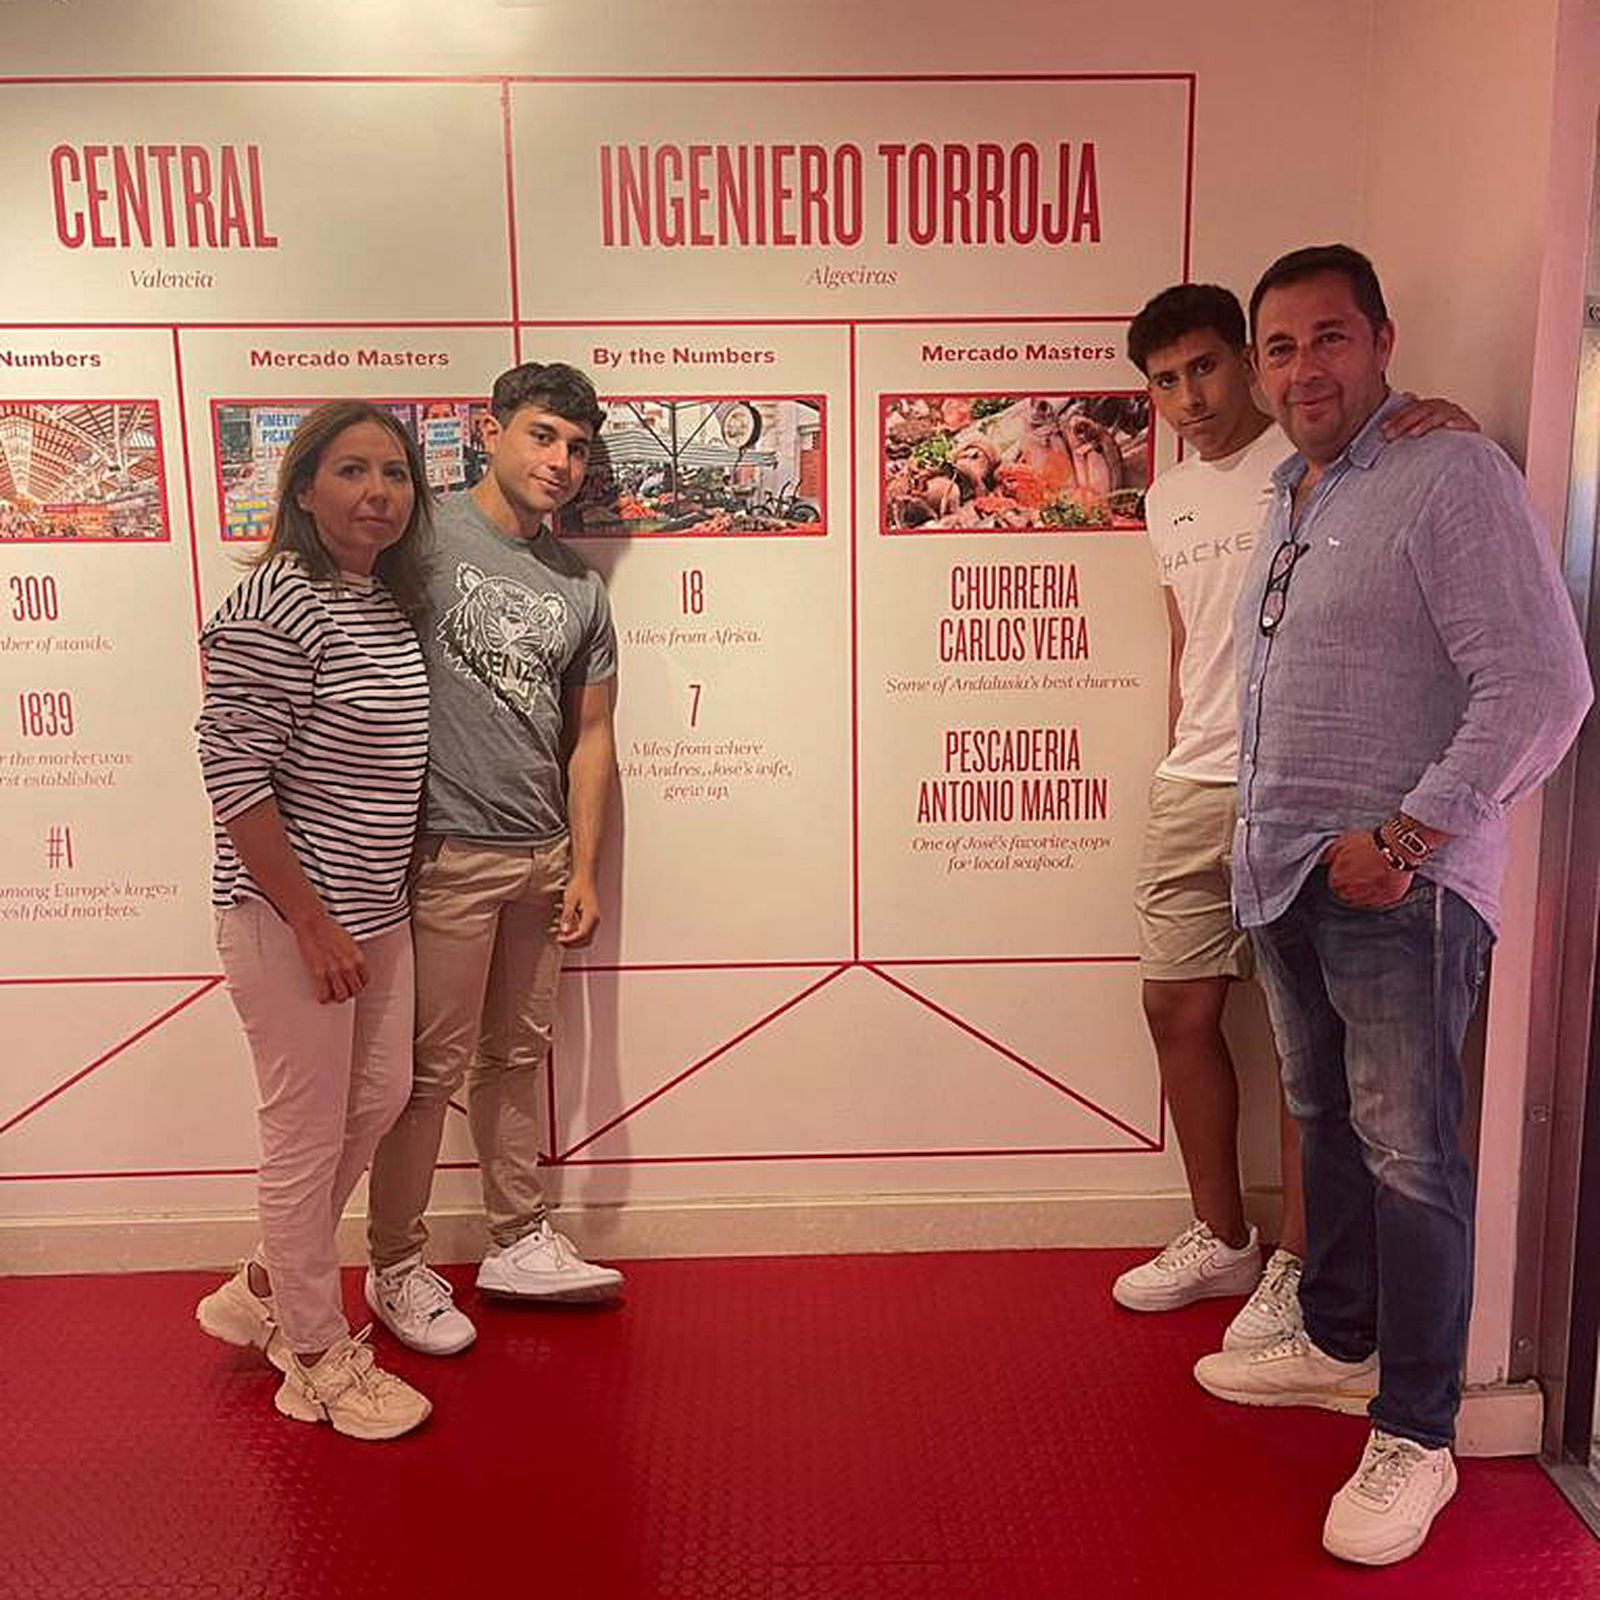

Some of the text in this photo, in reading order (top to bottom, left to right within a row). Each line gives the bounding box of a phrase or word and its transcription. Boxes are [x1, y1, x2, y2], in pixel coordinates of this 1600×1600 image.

[51, 145, 278, 248] CENTRAL
[600, 142, 1101, 248] INGENIERO TORROJA
[129, 268, 214, 289] Valencia
[806, 265, 898, 290] Algeciras
[0, 350, 101, 368] Numbers
[250, 349, 450, 367] Mercado Masters
[592, 347, 776, 368] By the Numbers
[921, 343, 1116, 363] Mercado Masters
[1162, 532, 1253, 572] HACKE
[10, 575, 58, 622] 300
[682, 569, 703, 614] 18
[950, 564, 1079, 611] CHURRERIA
[0, 636, 34, 651] ber
[36, 636, 54, 655] of
[623, 629, 666, 645] Miles
[667, 629, 707, 648] from
[939, 615, 1089, 662] CARLOS VERA
[886, 677, 931, 695] Some
[933, 677, 950, 698] of
[951, 675, 1039, 693] Andalusia's
[1042, 674, 1073, 690] best
[20, 692, 74, 737] 1839
[689, 684, 701, 728] 7
[10, 752, 36, 767] the
[38, 751, 98, 766] market
[631, 739, 763, 759] Miles from where
[946, 728, 1080, 773] PESCADERIA
[664, 784, 704, 800] grew
[917, 778, 1108, 823] ANTONIO MARTIN
[46, 826, 73, 868] #1
[912, 835, 946, 852] One
[947, 835, 963, 853] of
[1008, 833, 1070, 853] favorite
[948, 853, 1074, 875] for local seafood.
[53, 881, 121, 901] Europe's
[31, 902, 69, 922] food
